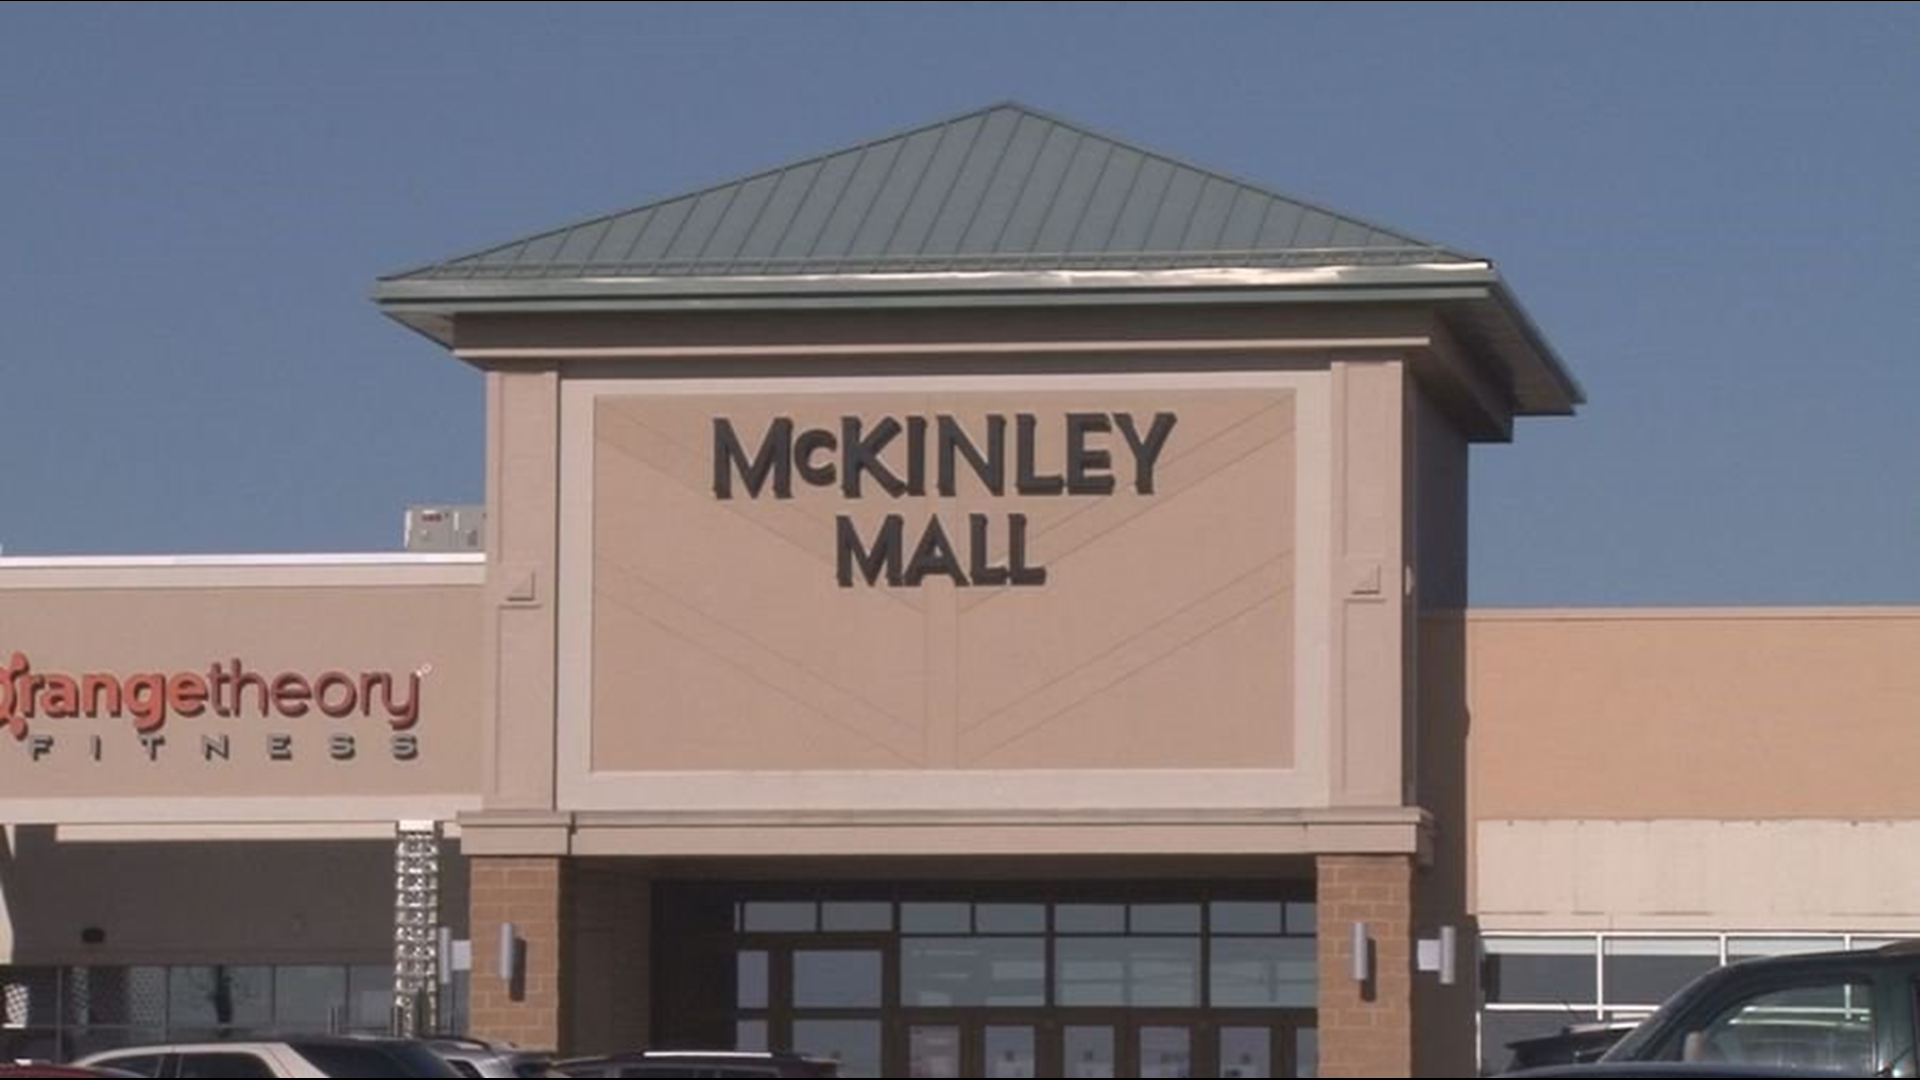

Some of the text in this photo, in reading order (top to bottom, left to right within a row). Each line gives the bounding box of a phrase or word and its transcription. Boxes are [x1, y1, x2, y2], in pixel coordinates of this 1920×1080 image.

[713, 412, 1177, 500] McKINLEY
[836, 514, 1046, 587] MALL
[29, 734, 418, 761] FITNESS
